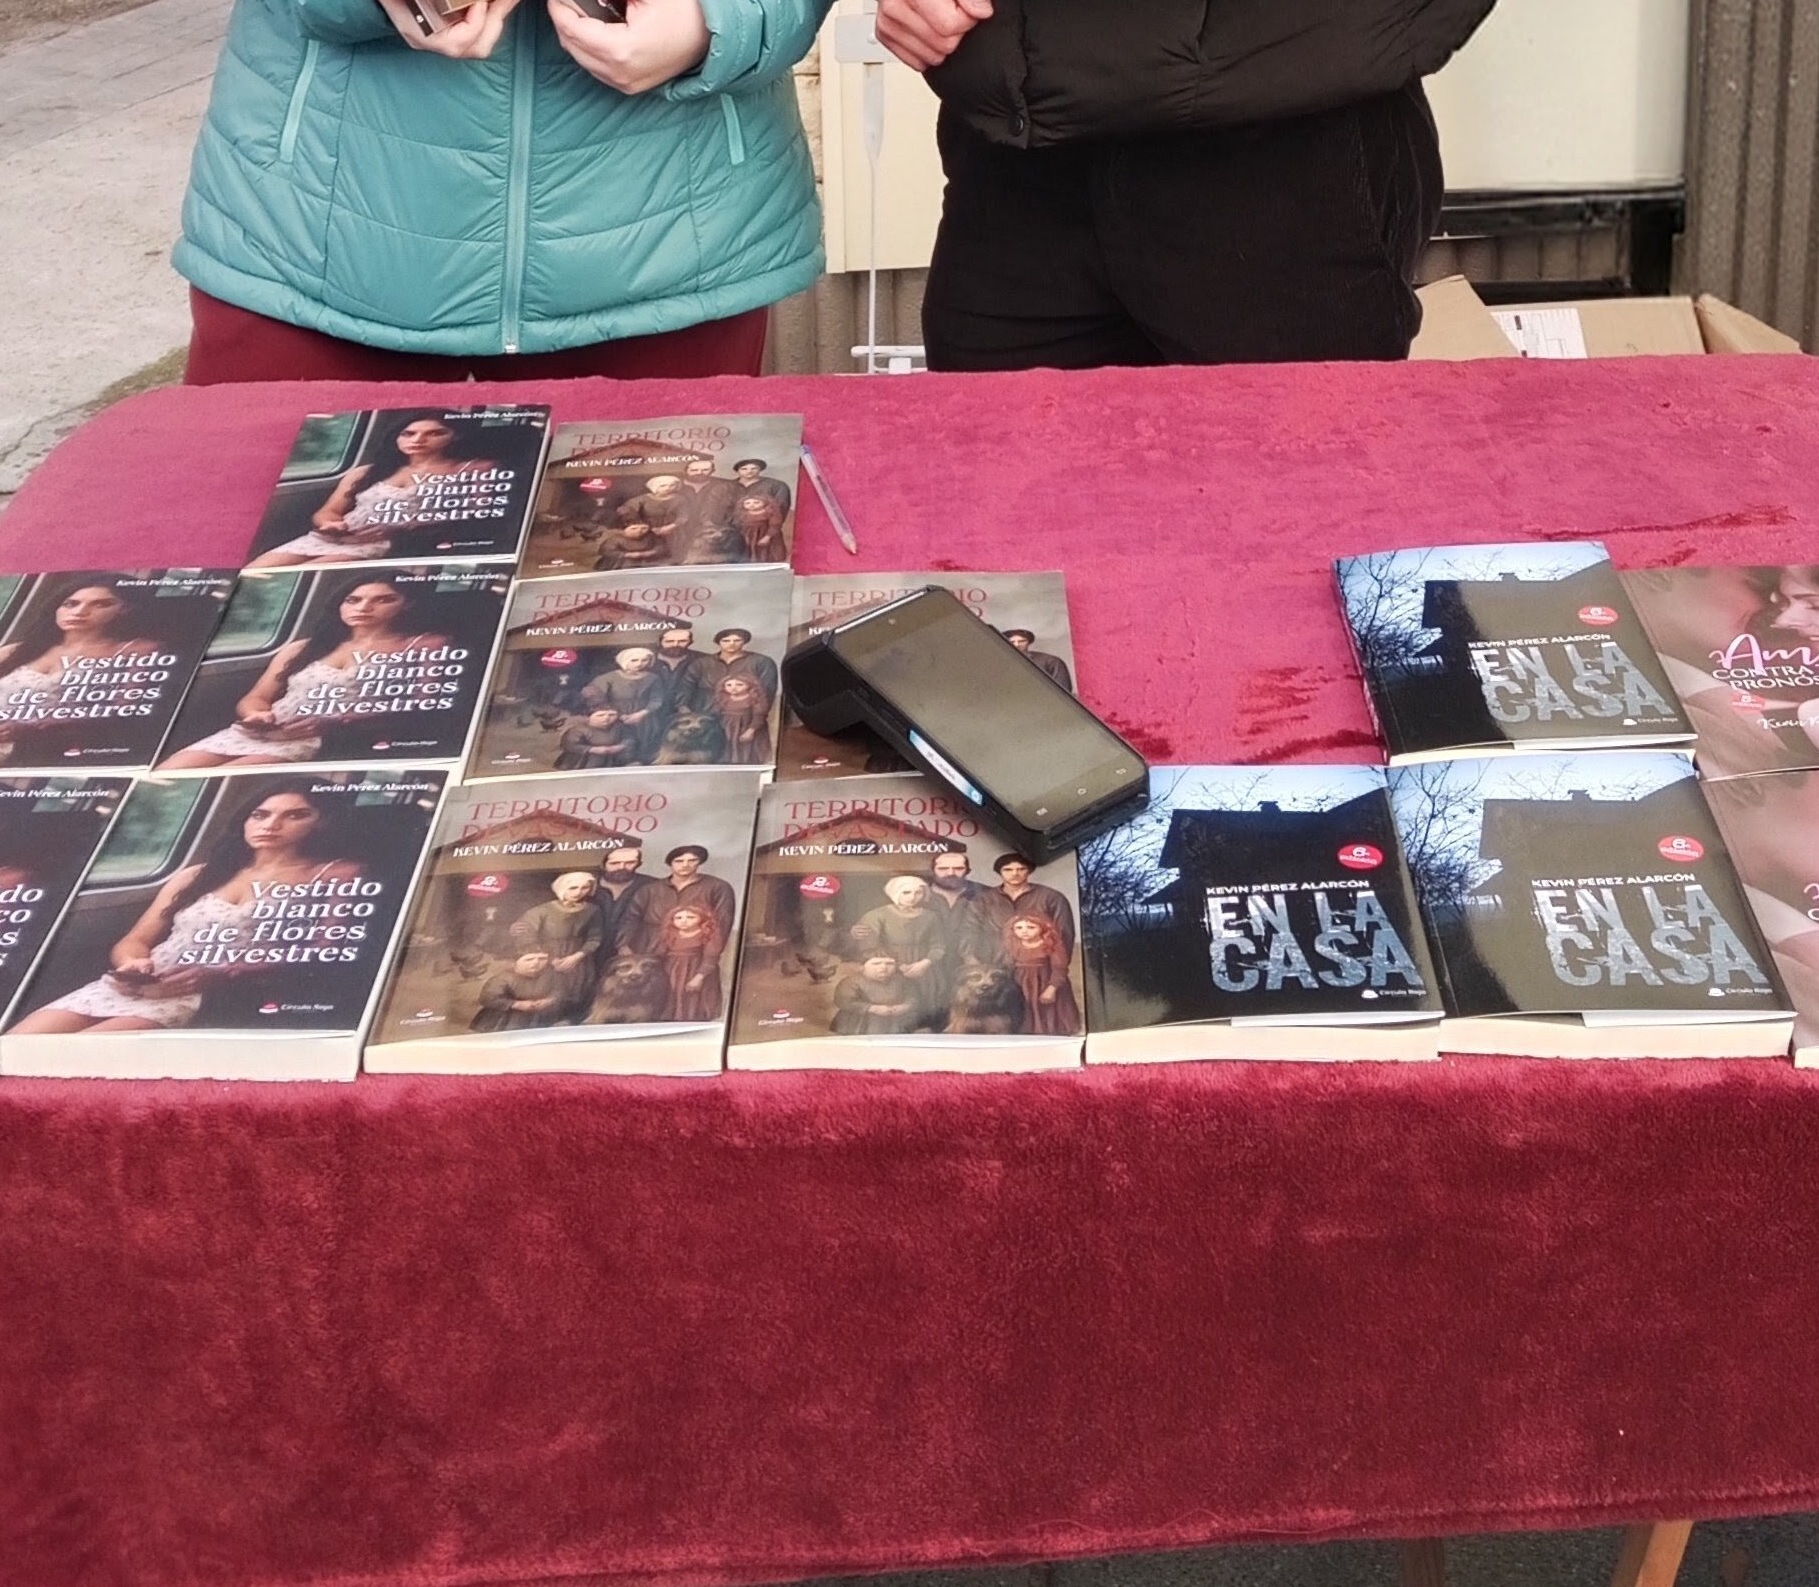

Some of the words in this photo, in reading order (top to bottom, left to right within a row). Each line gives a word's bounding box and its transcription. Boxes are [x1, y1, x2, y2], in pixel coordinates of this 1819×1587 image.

[573, 427, 731, 446] TERRITORIO
[565, 459, 601, 468] KEVIN
[412, 468, 515, 485] Vestido
[416, 482, 512, 497] blanco
[374, 498, 408, 513] de
[421, 493, 509, 510] flores
[366, 507, 505, 525] silvestres
[535, 586, 712, 609] TERRITORIO
[526, 626, 567, 637] KEVIN
[569, 623, 612, 634] PÉREZ
[615, 621, 677, 631] ALARCÓN
[1468, 640, 1506, 649] KEVIN
[60, 651, 176, 671] Vestido
[352, 646, 468, 664] Vestido
[1470, 645, 1546, 683] EN
[1564, 642, 1640, 678] LA
[60, 668, 170, 686] blanco
[355, 663, 463, 681] blanco
[1712, 664, 1815, 680] CONTRA
[8, 688, 48, 705] de
[59, 685, 162, 703] flores
[307, 683, 347, 700] de
[359, 680, 459, 698] flores
[1482, 671, 1676, 724] CASA
[0, 703, 153, 721] silvestres
[296, 696, 454, 716] silvestres
[311, 783, 346, 792] Kevin
[467, 792, 668, 821] TERRITORIO
[452, 844, 499, 858] KEVIN
[501, 840, 552, 854] PÉREZ
[552, 837, 625, 852] ALARCÓN
[779, 844, 825, 857] KEVIN
[828, 841, 877, 855] PÉREZ
[878, 840, 949, 854] ALARCÓN
[250, 876, 382, 900] Vestido
[1205, 885, 1249, 895] KEVIN
[1252, 882, 1299, 893] PÉREZ
[1300, 879, 1370, 890] ALARCÓN
[1531, 878, 1575, 888] KEVIN
[1577, 876, 1624, 886] PÉREZ
[1626, 873, 1696, 885] ALARCÓN
[252, 898, 375, 921] blanco
[1205, 893, 1289, 939] EN
[1314, 890, 1400, 932] LA
[1533, 888, 1625, 933] EN
[1644, 884, 1728, 929] LA
[194, 923, 237, 944] de
[251, 920, 367, 943] flores
[178, 941, 359, 967] silvestres
[1209, 927, 1425, 992] CASA
[1546, 924, 1769, 986] CASA
